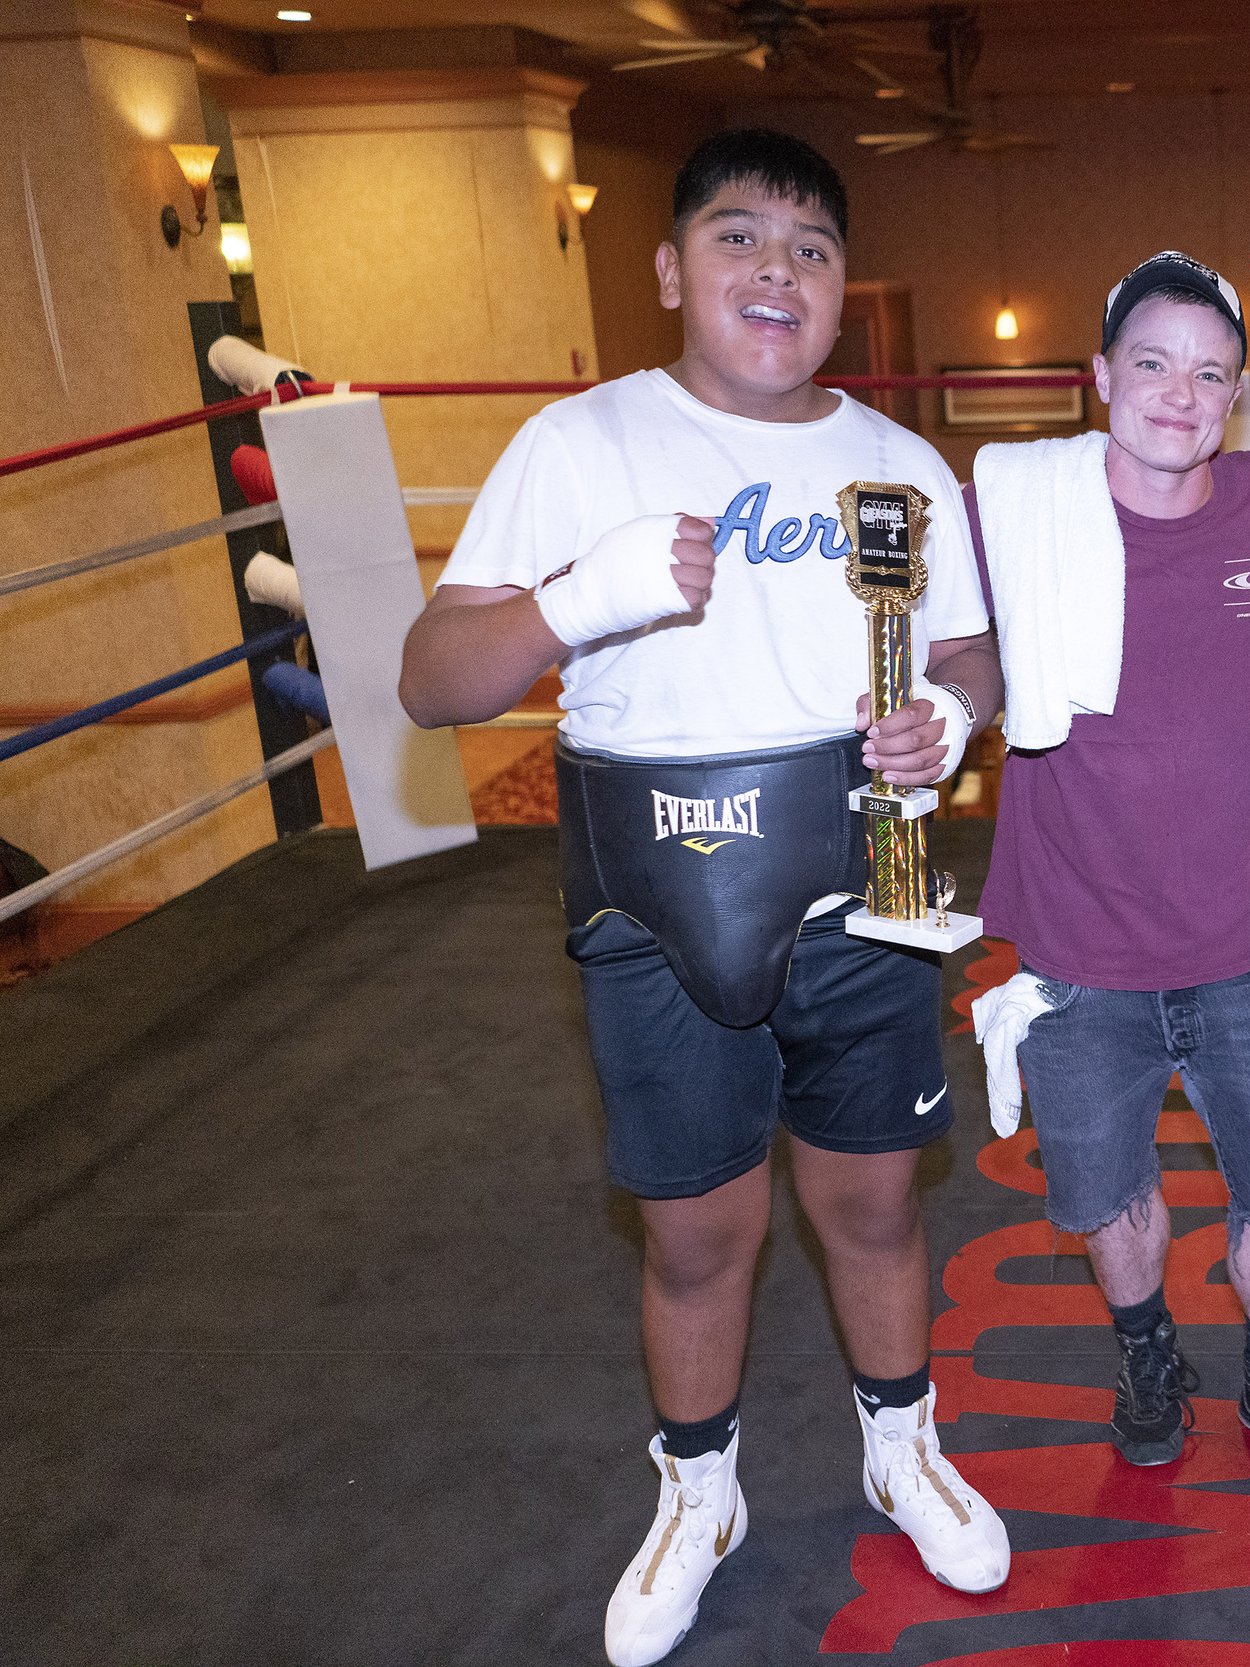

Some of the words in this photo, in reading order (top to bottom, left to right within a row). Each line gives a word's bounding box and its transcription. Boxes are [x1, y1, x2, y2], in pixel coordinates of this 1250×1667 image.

[713, 481, 853, 565] Aer
[861, 548, 886, 558] AMATEUR
[888, 551, 908, 560] BOXING
[651, 787, 762, 841] EVERLAST
[868, 800, 890, 813] 2022
